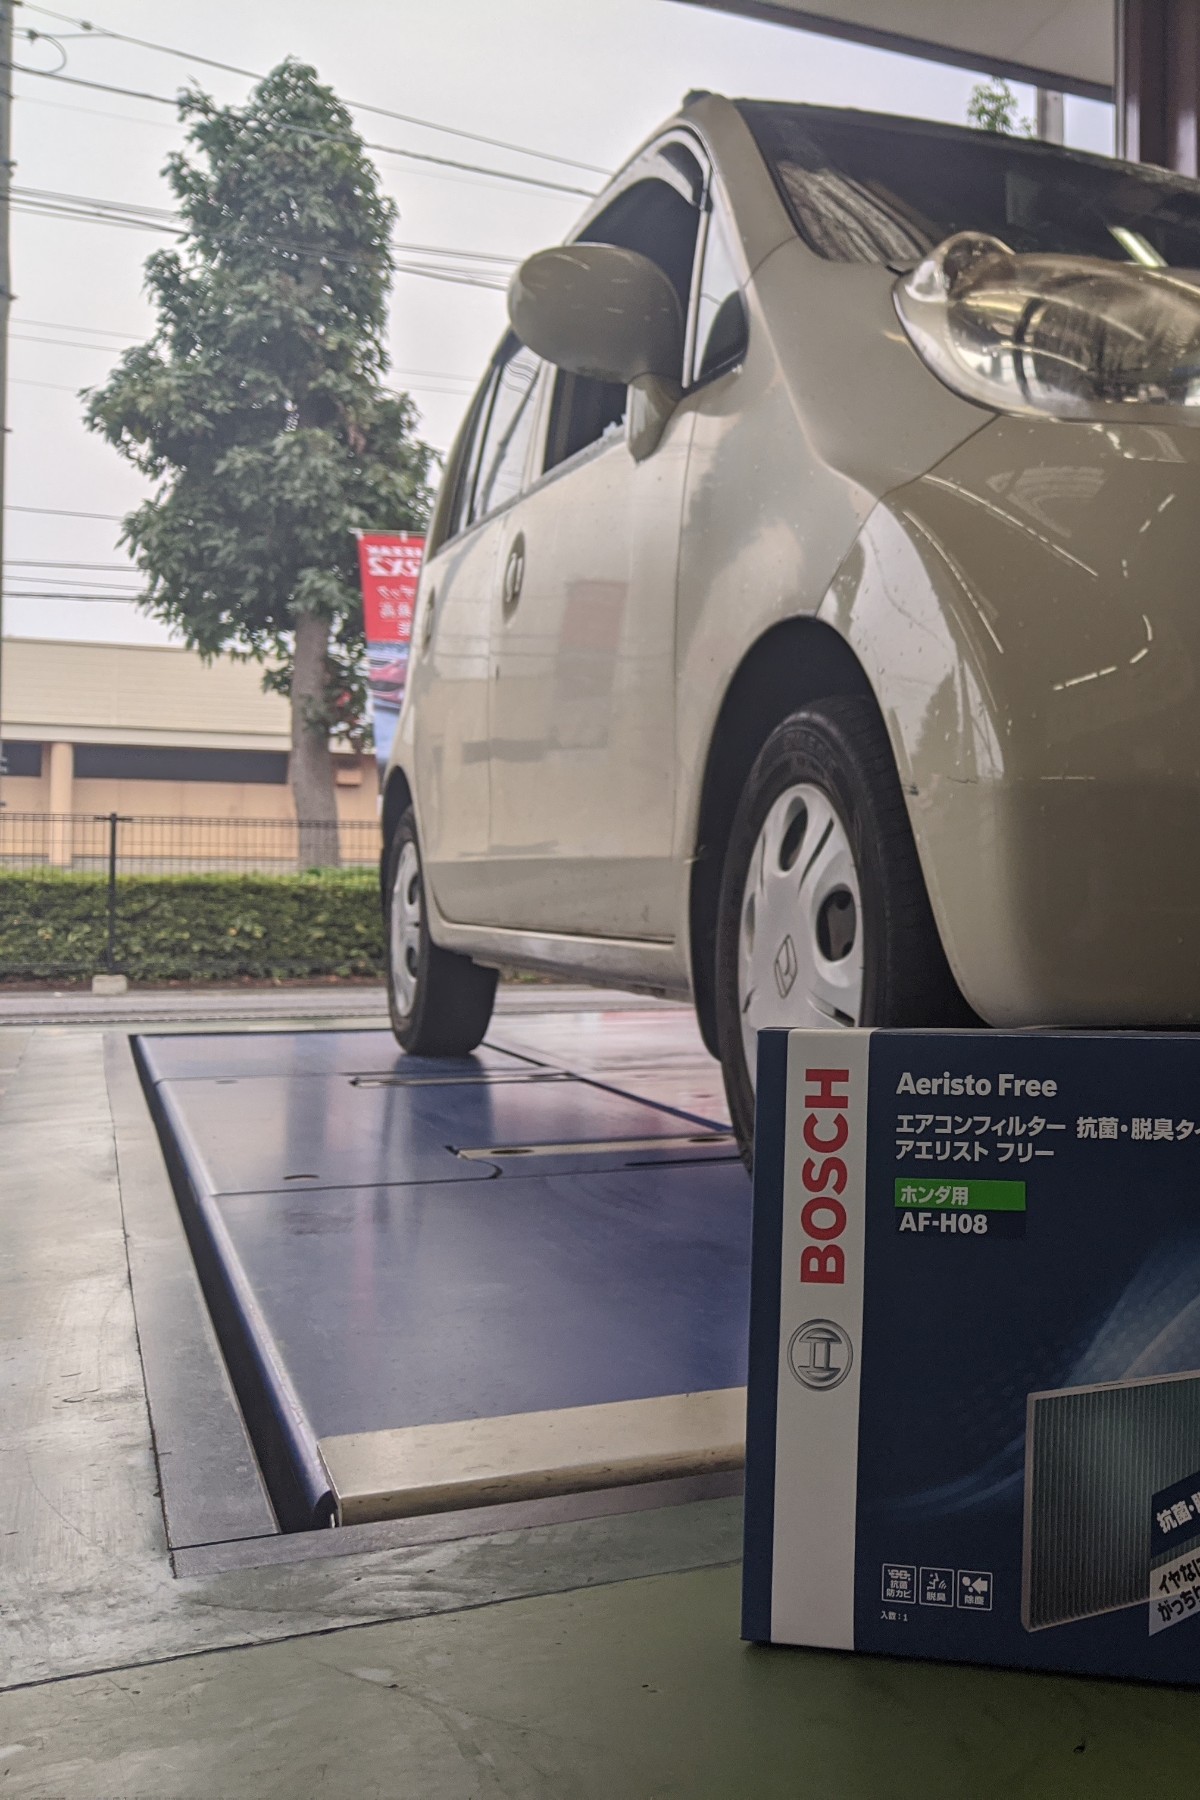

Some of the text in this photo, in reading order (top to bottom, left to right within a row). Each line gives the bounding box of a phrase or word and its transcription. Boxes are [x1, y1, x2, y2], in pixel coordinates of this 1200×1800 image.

[895, 1072, 1058, 1097] Aeristo Free
[895, 1113, 1067, 1137] エアコンフィルター
[895, 1140, 1055, 1163] アエリスト フリー
[800, 1069, 850, 1285] BOSCH
[900, 1186, 969, 1206] ホンダ用
[899, 1212, 988, 1235] AF-H08
[886, 1588, 912, 1599] 防カビ
[927, 1592, 946, 1601] 脱臭
